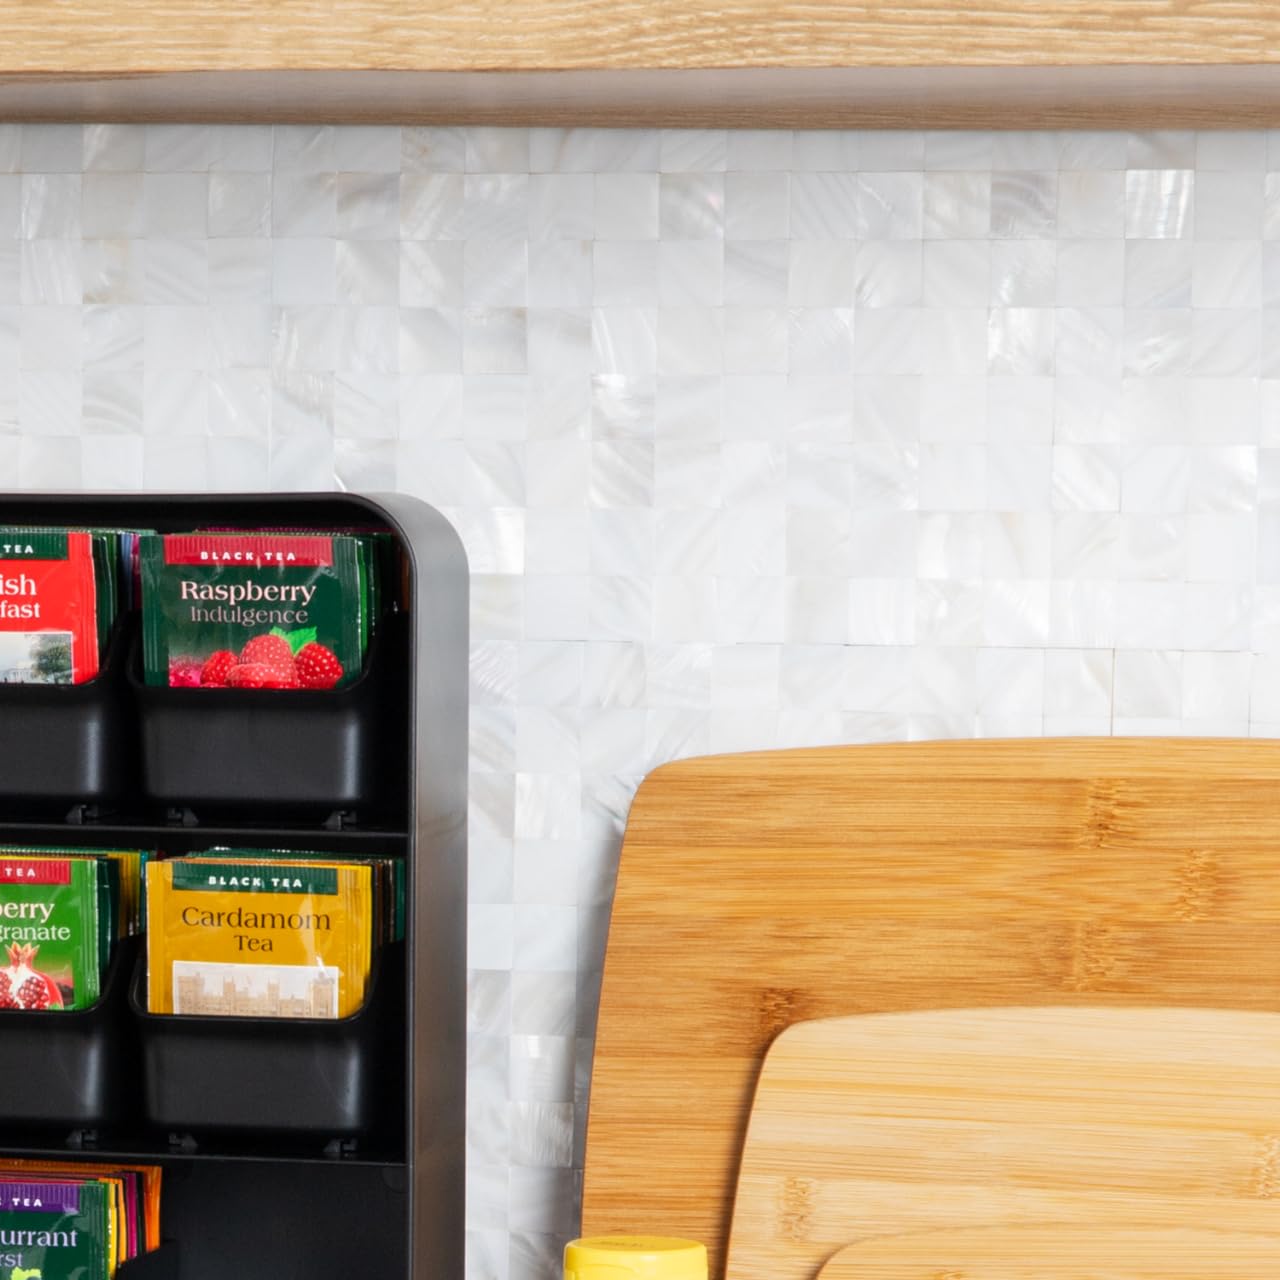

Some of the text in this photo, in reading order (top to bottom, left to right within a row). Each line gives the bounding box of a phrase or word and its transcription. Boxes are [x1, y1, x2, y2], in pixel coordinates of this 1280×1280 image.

[3, 544, 34, 554] TEA
[200, 551, 296, 561] BLACK TEA
[180, 581, 317, 606] Raspberry
[191, 606, 309, 627] Indulgence
[5, 867, 36, 877] TEA
[208, 876, 302, 888] BLACK TEA
[181, 906, 331, 930] Cardamom
[233, 935, 274, 952] Tea
[12, 1197, 43, 1207] TEA
